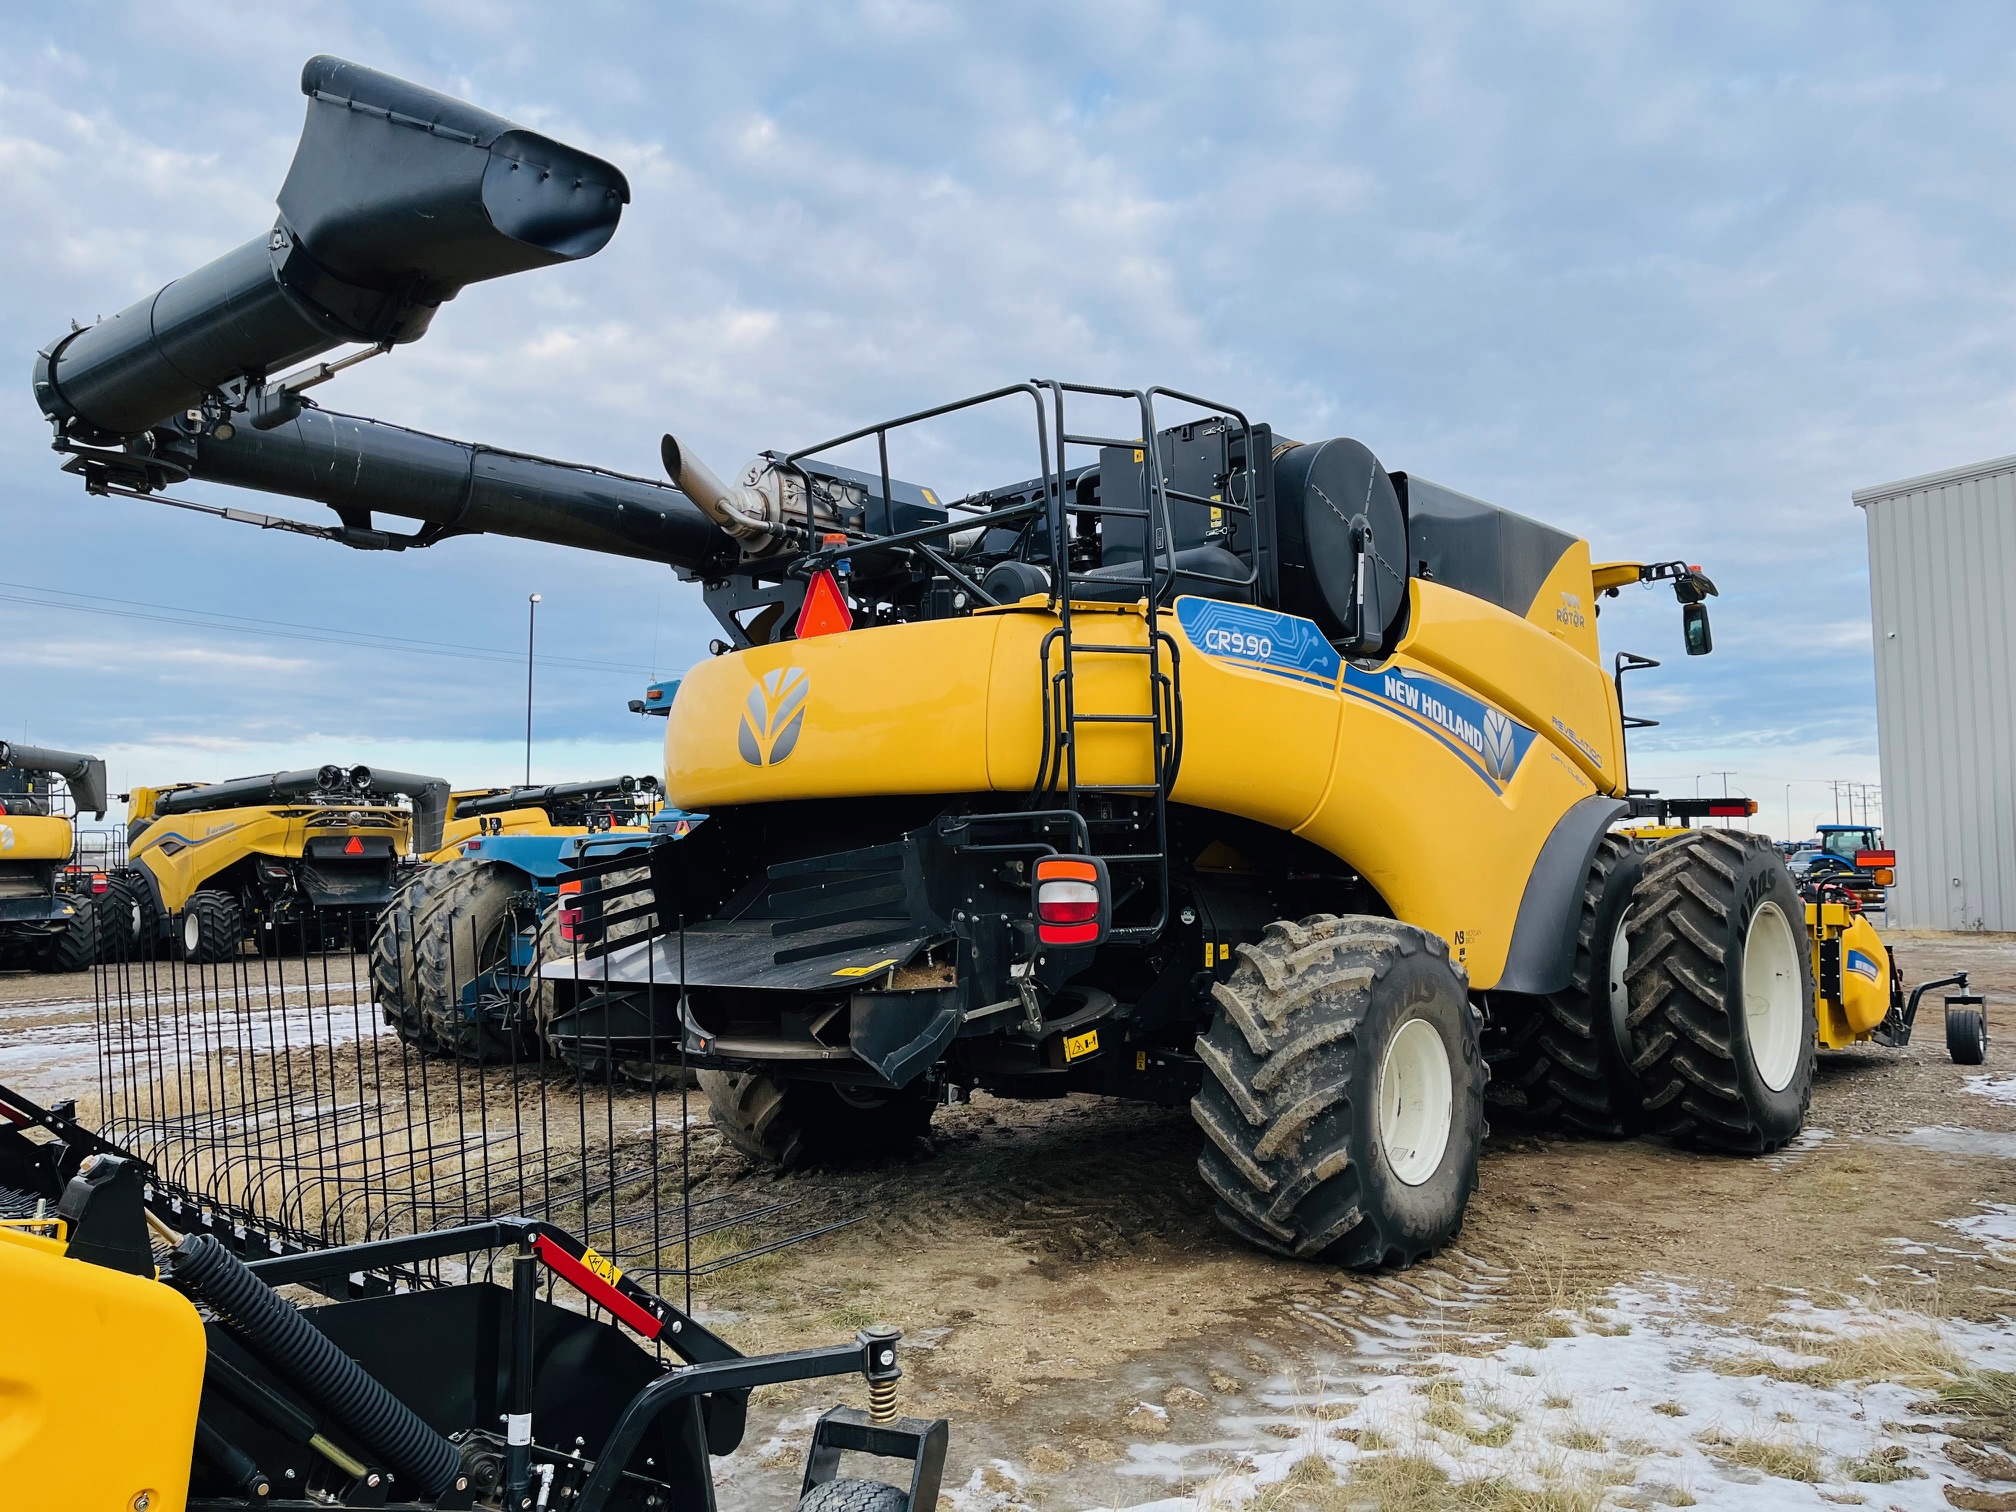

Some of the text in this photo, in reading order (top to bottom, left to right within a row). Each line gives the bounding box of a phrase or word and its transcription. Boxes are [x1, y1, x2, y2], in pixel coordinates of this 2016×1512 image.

[1556, 607, 1585, 628] ROTOR
[1205, 629, 1272, 658] CR9.90
[1384, 674, 1483, 753] NEW HOLLAND
[1551, 715, 1602, 766] REVELATION
